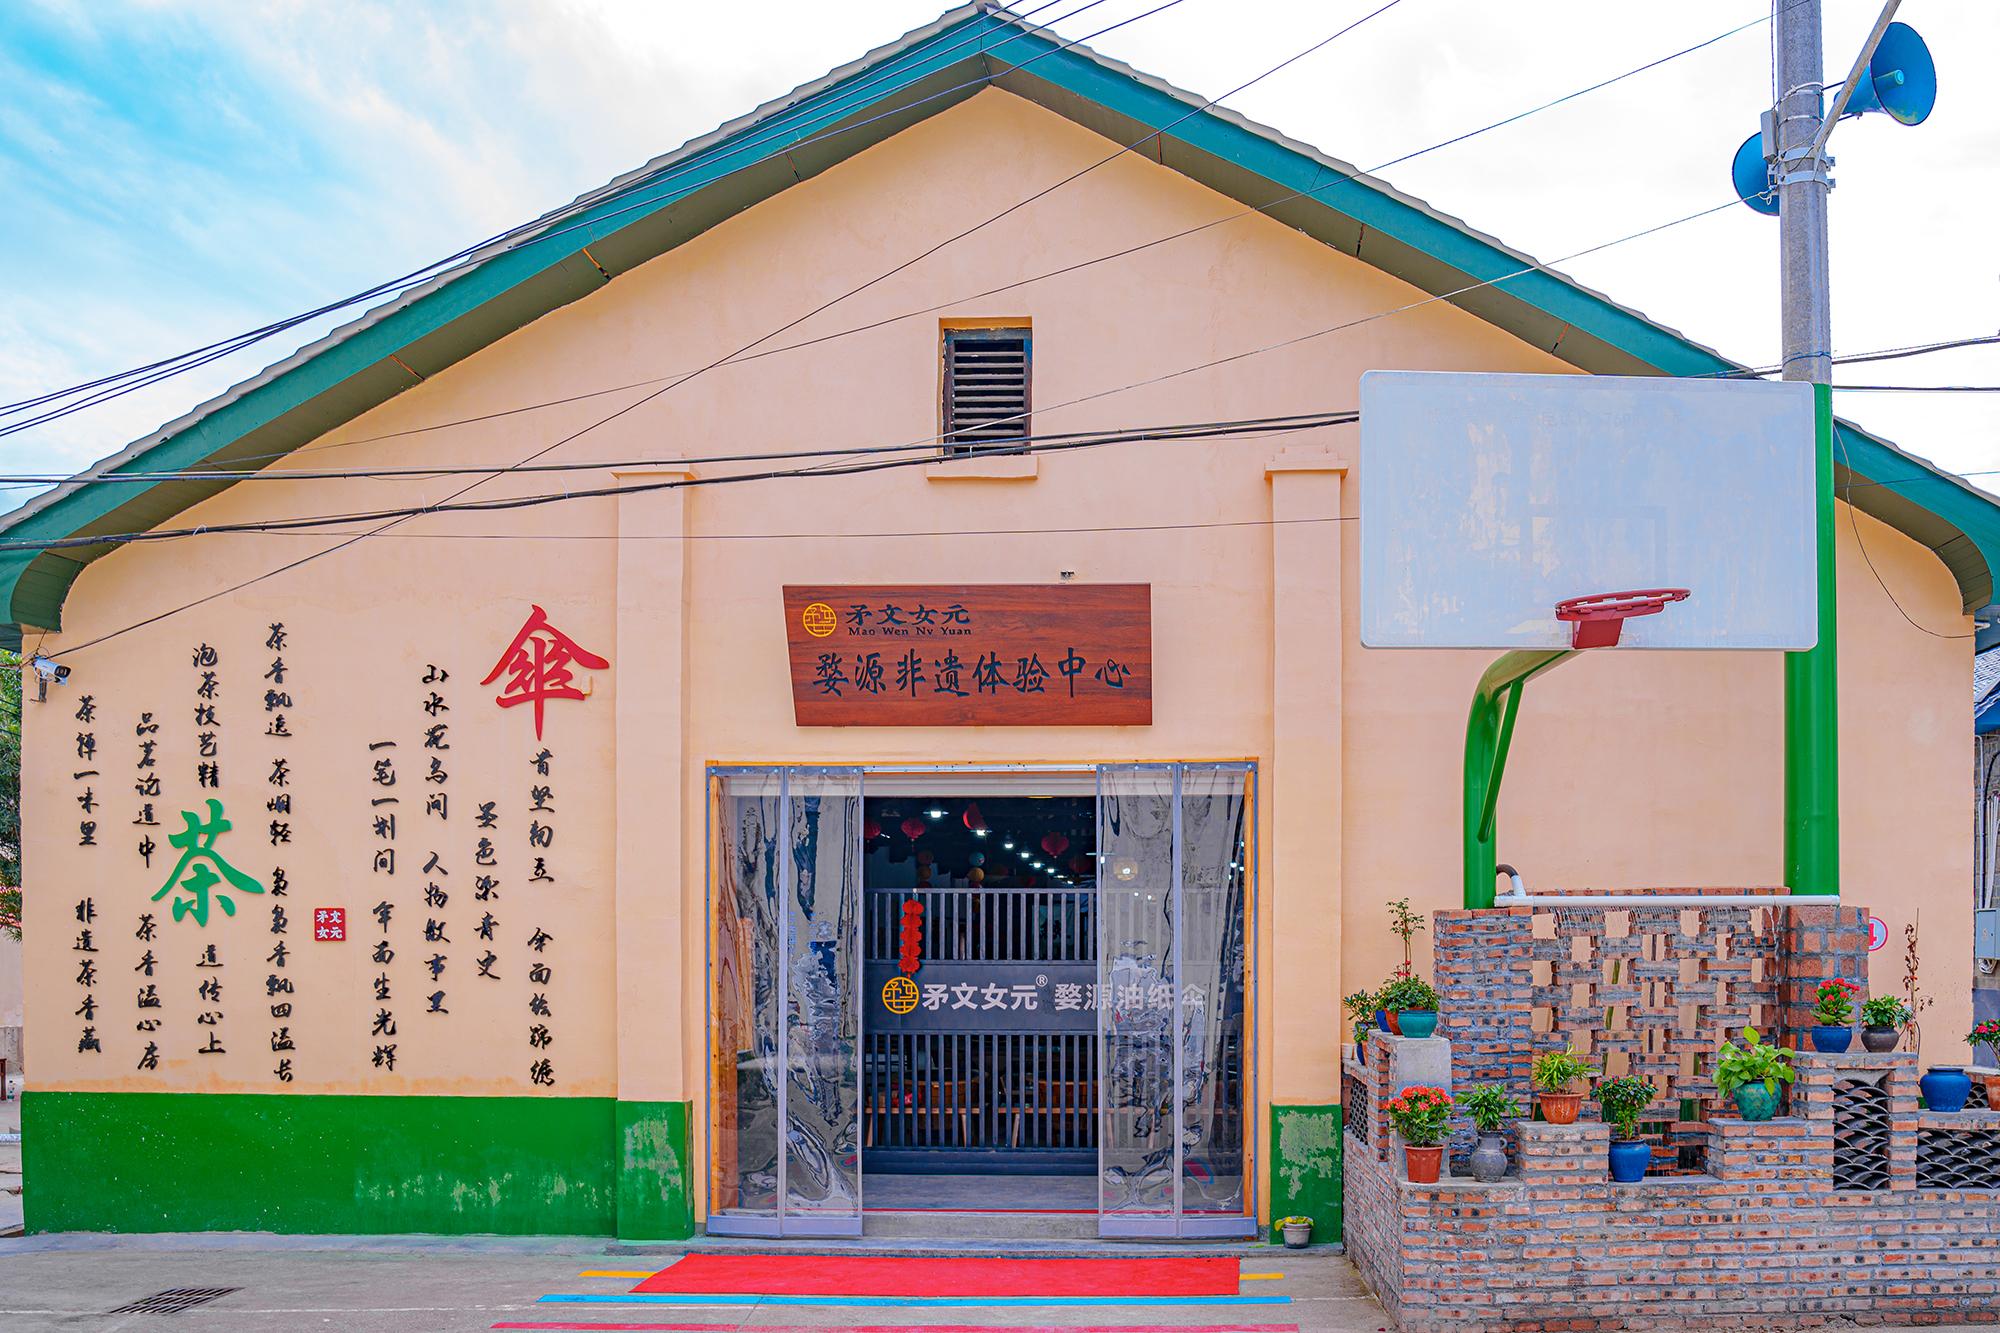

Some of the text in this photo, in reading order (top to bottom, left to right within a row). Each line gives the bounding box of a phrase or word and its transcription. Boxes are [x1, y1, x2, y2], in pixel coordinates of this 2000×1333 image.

[845, 603, 971, 626] 矛文女元
[848, 626, 876, 636] Mao
[883, 626, 909, 636] Wen
[940, 626, 972, 636] Yuan
[812, 647, 1132, 698] 婺源非遗体验中心
[151, 799, 266, 927] 茶
